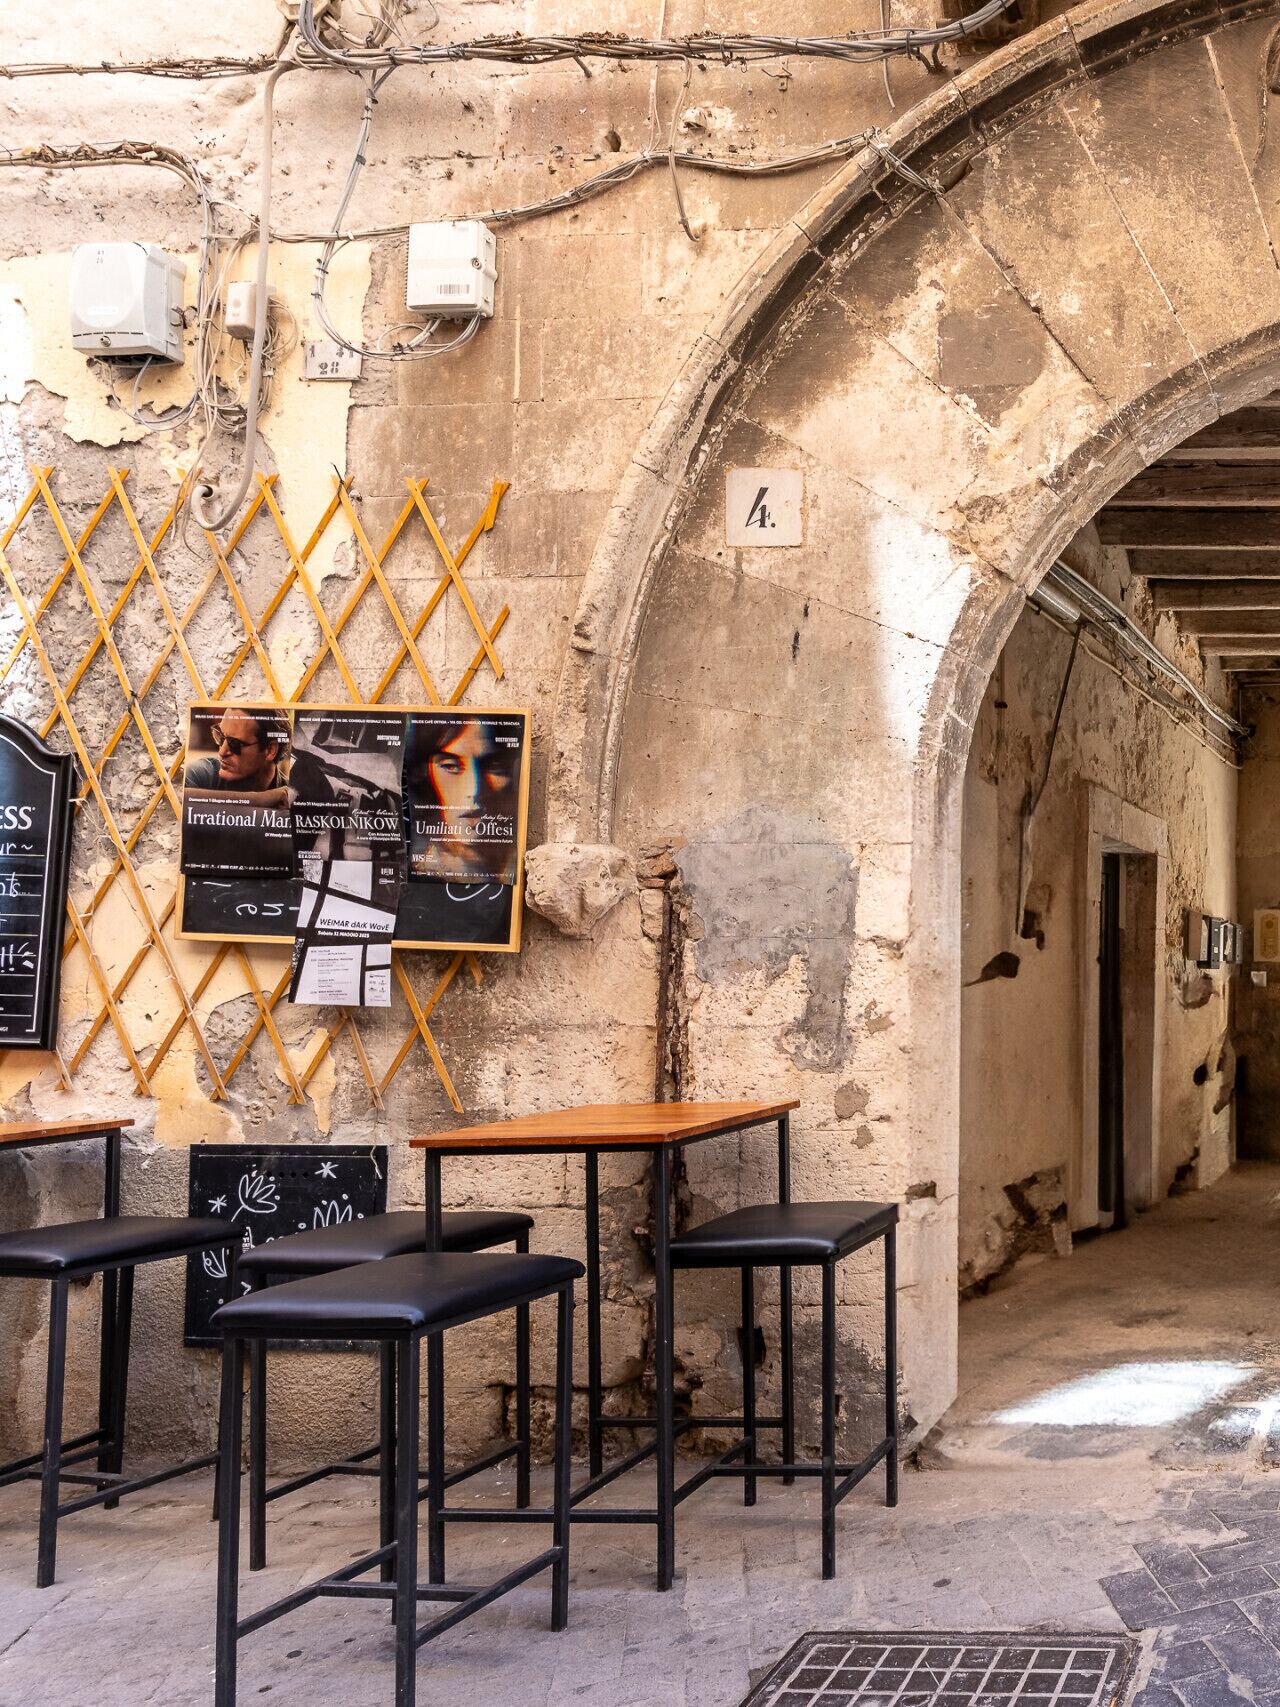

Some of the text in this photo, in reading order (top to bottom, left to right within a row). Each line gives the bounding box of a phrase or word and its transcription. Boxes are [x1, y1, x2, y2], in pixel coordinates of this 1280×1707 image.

[187, 806, 257, 827] Irrational
[294, 815, 399, 830] RASKOLNIKOW
[416, 820, 514, 837] Umiliati e Offesi
[319, 918, 350, 929] WEIMAR
